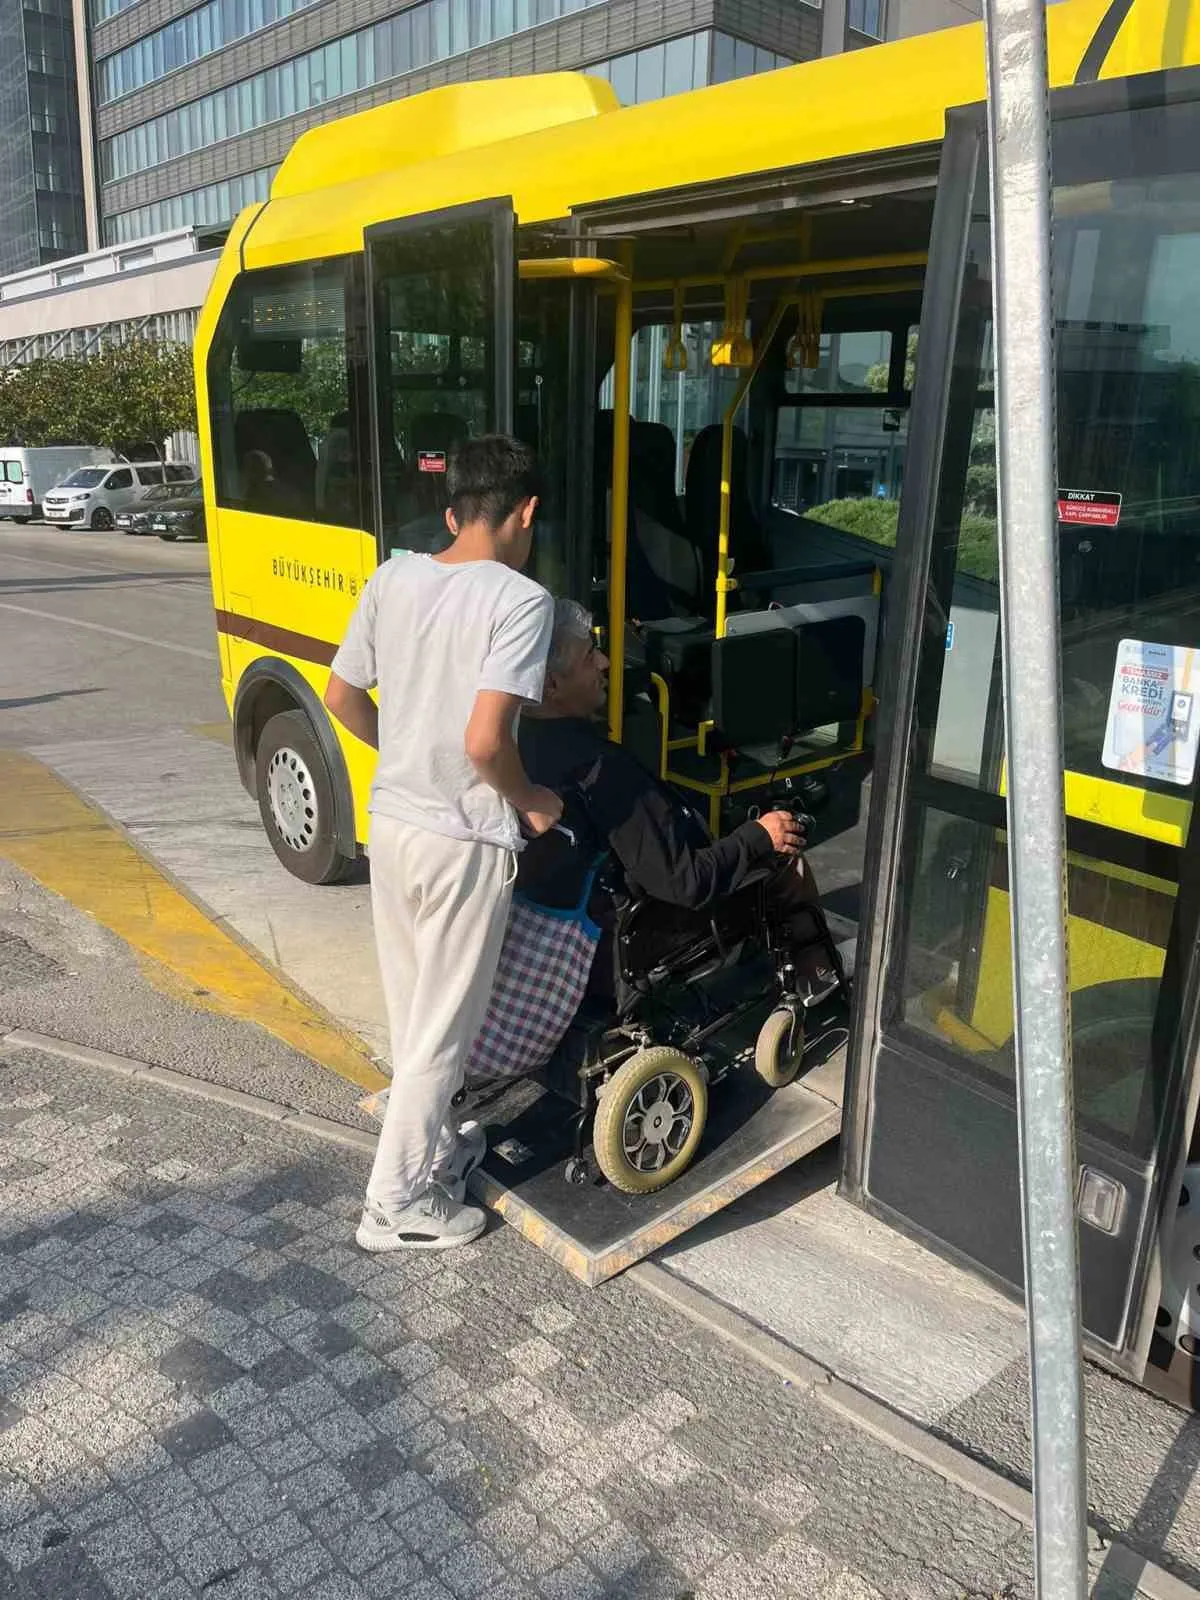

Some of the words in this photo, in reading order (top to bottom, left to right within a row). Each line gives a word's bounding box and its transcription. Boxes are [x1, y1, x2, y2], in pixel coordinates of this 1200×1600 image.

[272, 556, 344, 592] BÜYÜKŞEHİR
[1122, 676, 1157, 688] BANKA
[1121, 684, 1164, 699] KREDİ
